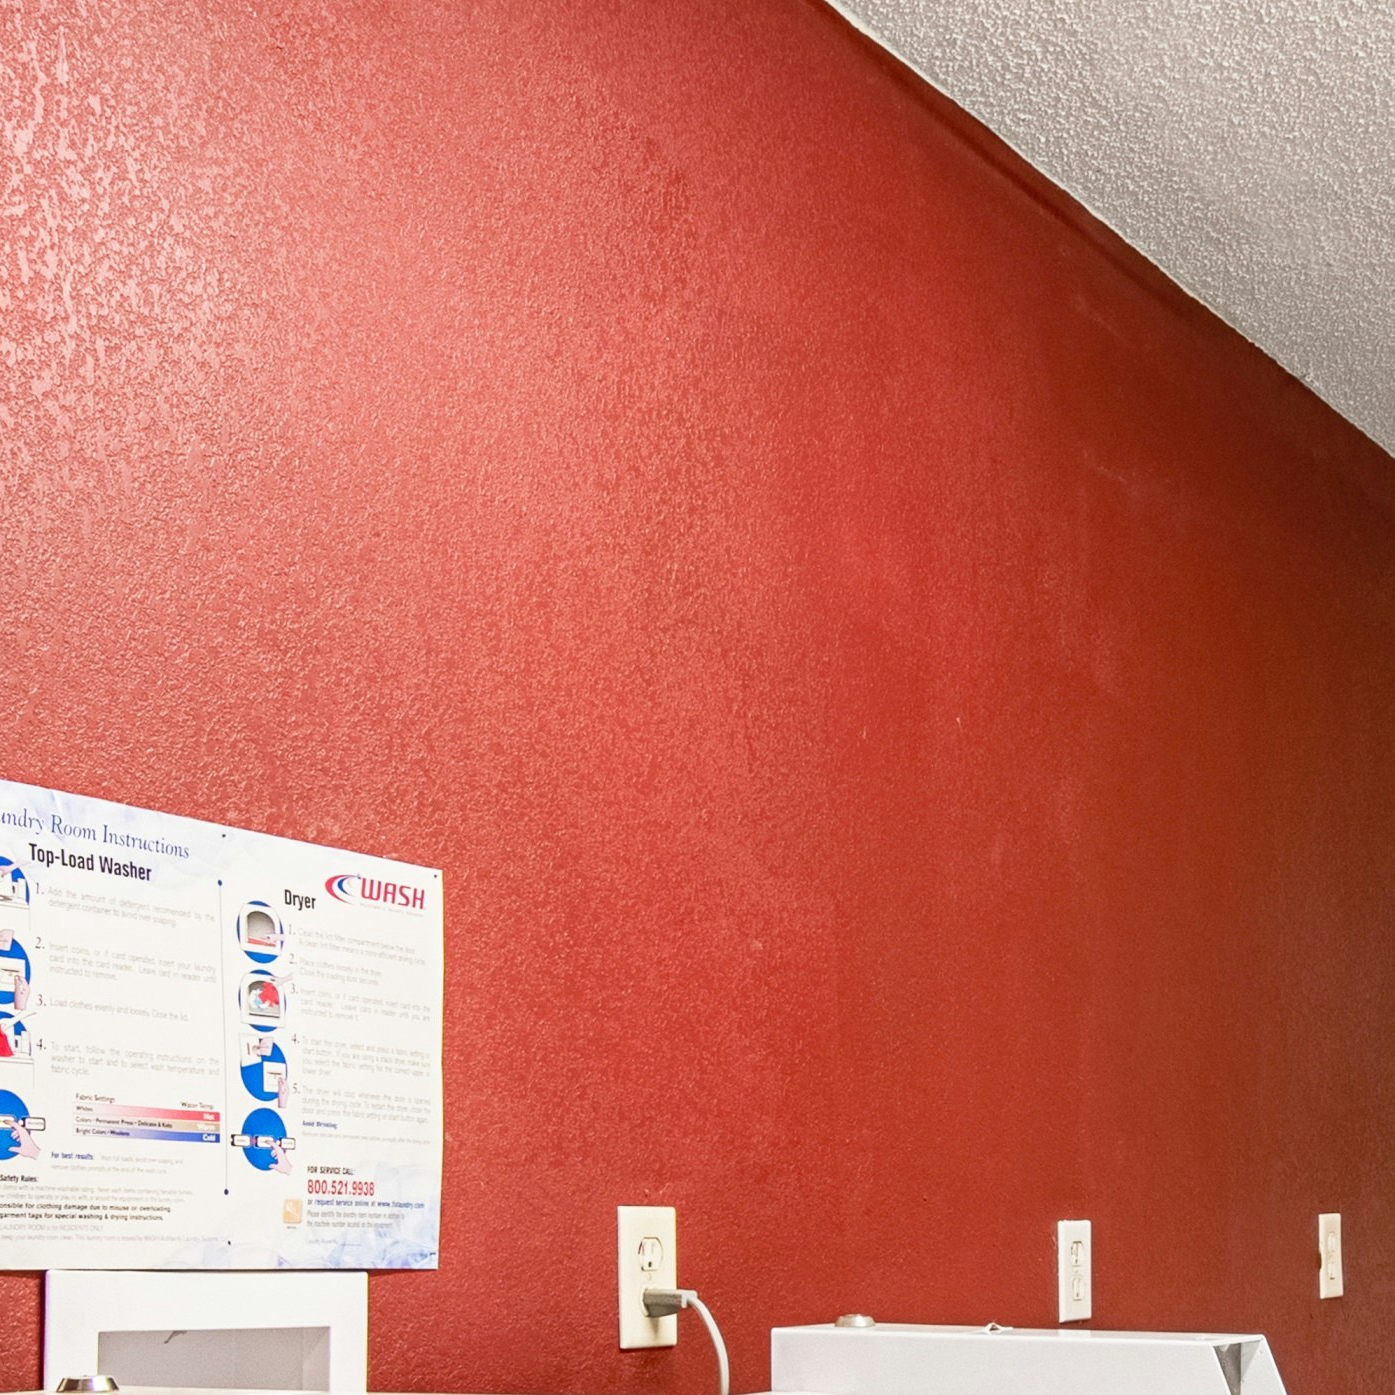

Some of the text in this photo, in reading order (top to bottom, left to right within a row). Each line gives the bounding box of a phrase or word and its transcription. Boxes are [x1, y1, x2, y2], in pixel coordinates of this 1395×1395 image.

[51, 814, 96, 841] Room
[103, 824, 190, 859] Instructions
[29, 843, 152, 881] Top-Load Washer
[284, 889, 316, 910] Dryer
[361, 877, 425, 910] WASH
[35, 937, 45, 949] 2.
[37, 994, 46, 1007] 3.
[37, 1038, 47, 1050] 4.
[320, 1166, 341, 1175] SERVICE
[307, 1180, 375, 1196] 800.521.9938
